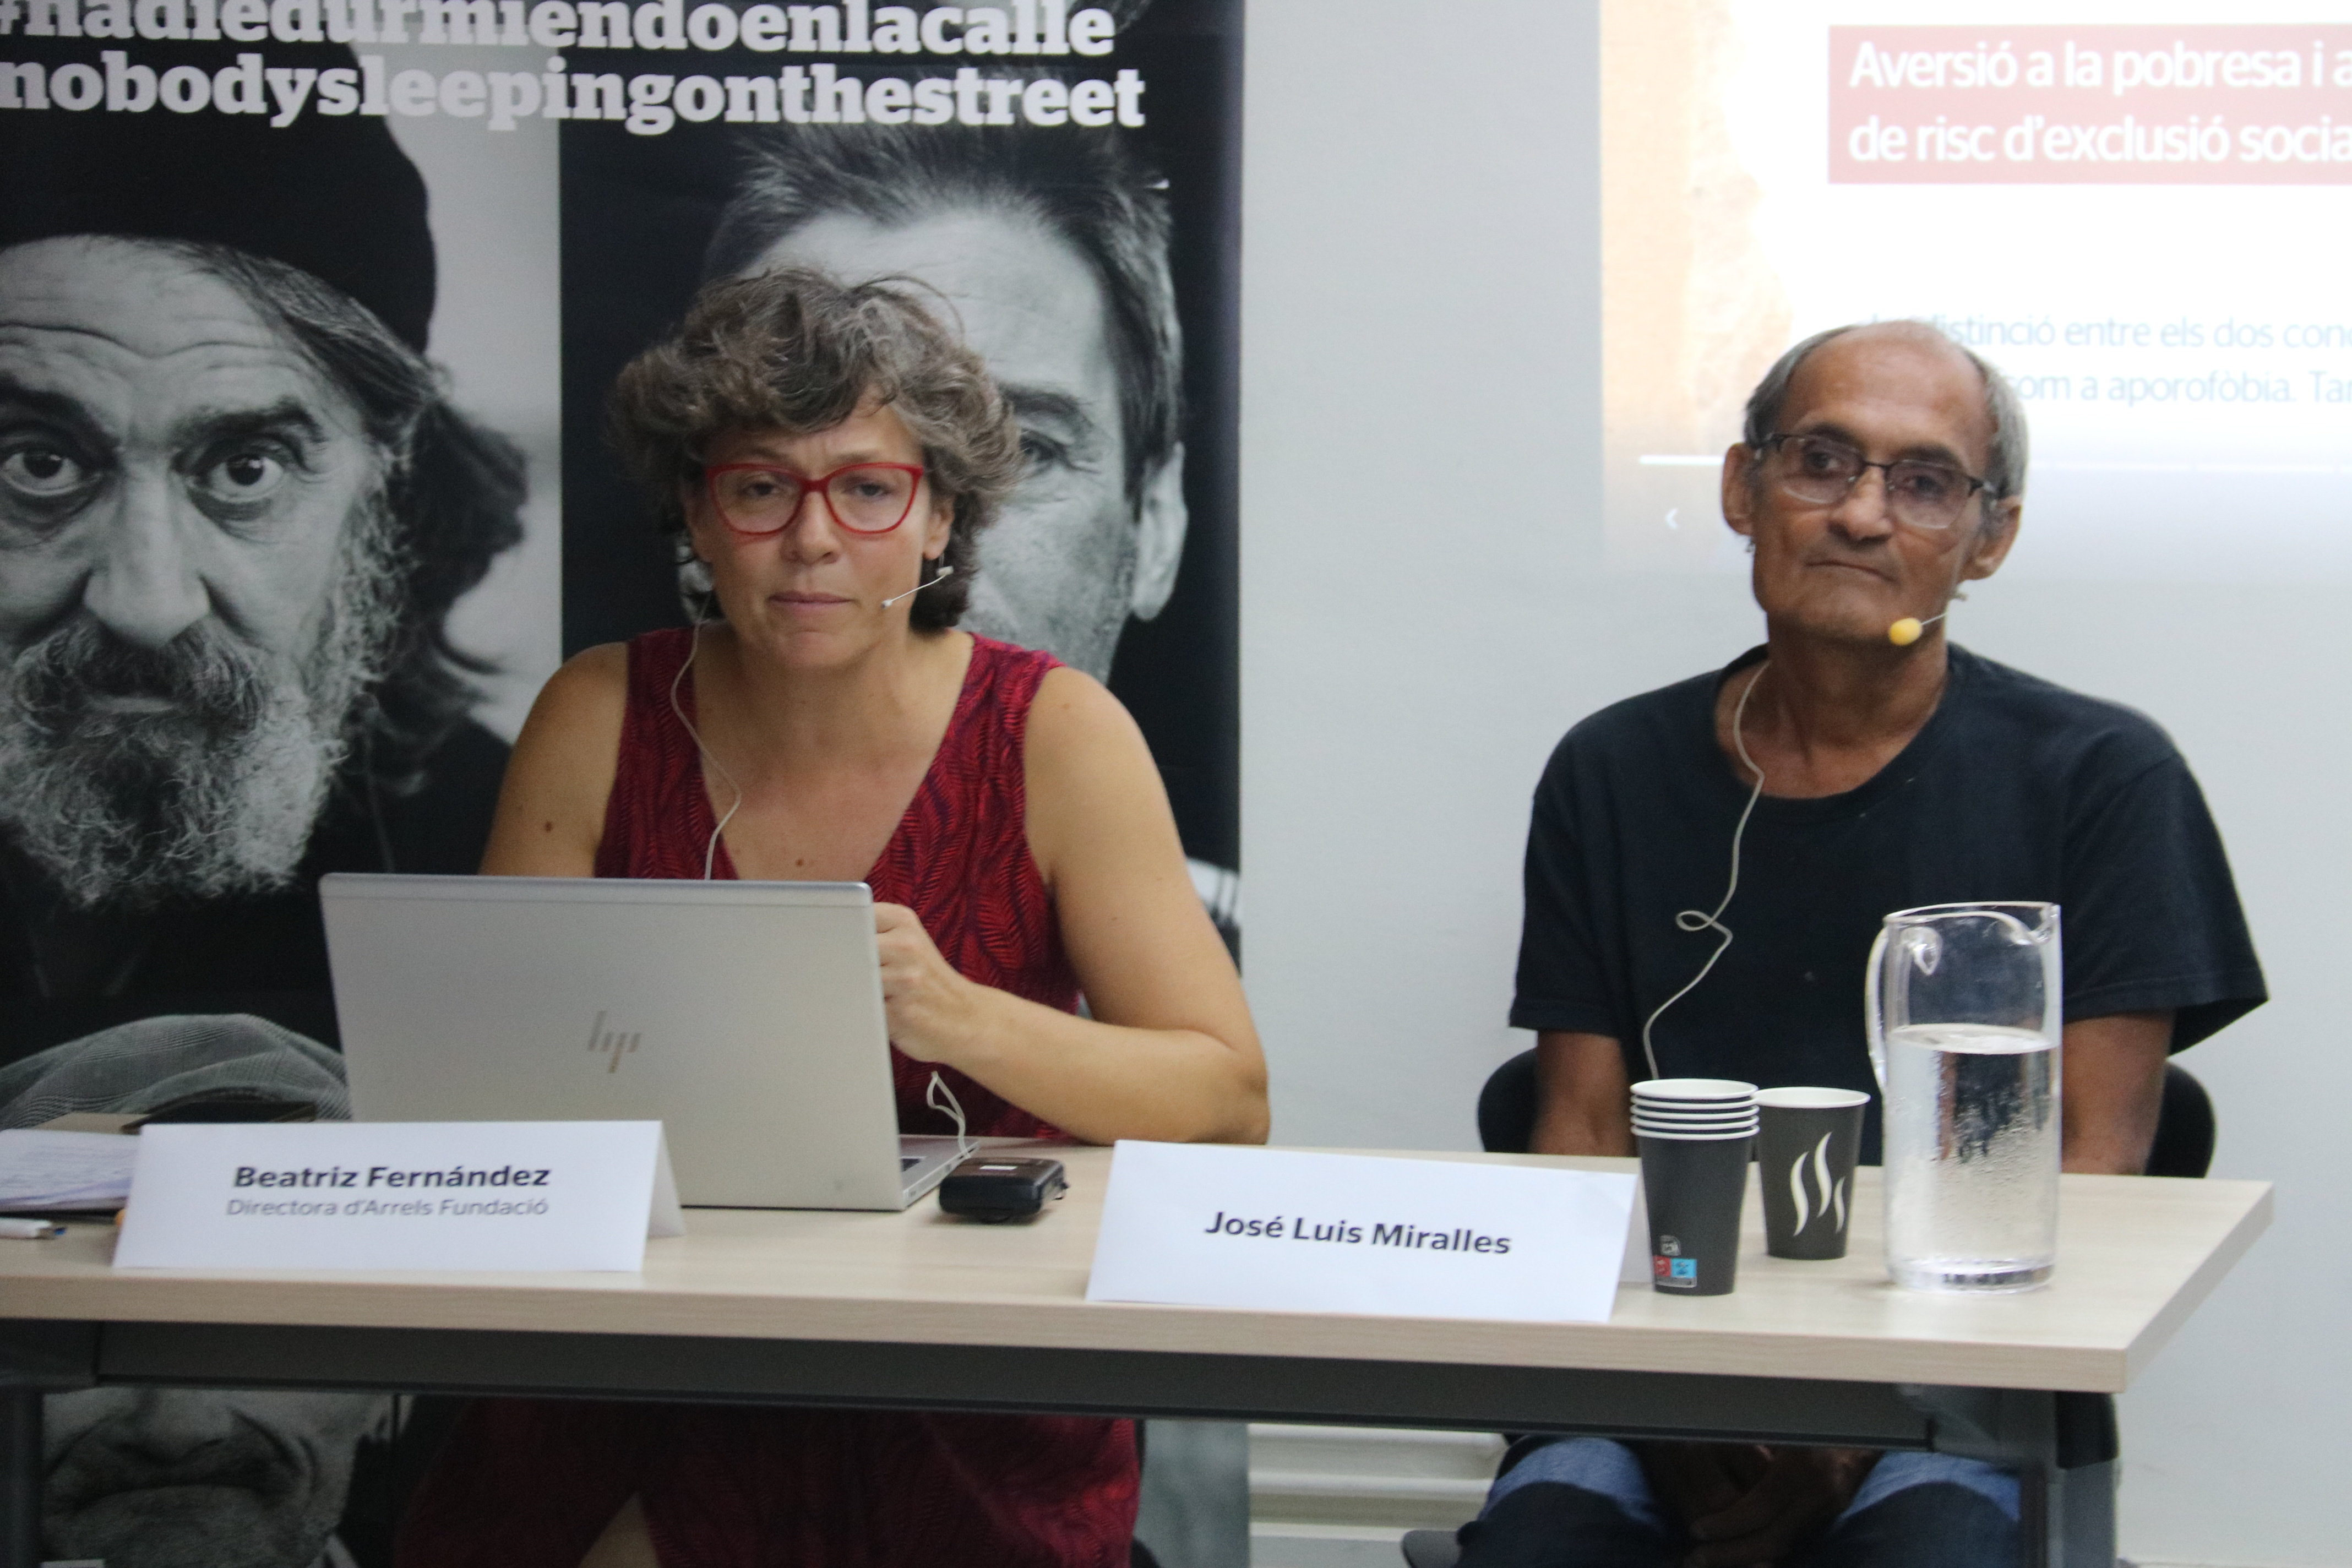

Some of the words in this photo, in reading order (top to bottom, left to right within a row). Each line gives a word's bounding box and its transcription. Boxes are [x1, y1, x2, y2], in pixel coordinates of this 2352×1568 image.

[1849, 40, 2018, 88] Aversió
[2026, 50, 2054, 87] a
[2065, 40, 2103, 87] la
[2113, 40, 2301, 96] pobresa
[2313, 40, 2324, 87] i
[0, 50, 1145, 135] nobodysleepingonthestreet
[1848, 115, 1908, 161] de
[1917, 115, 1996, 161] risc
[2064, 317, 2152, 347] entre
[2160, 315, 2206, 348] els
[2213, 317, 2274, 348] dos
[2080, 375, 2099, 401] a
[2107, 369, 2297, 409] aporofòbia.
[234, 1166, 358, 1188] Beatriz
[367, 1165, 551, 1188] Fernández
[226, 1199, 337, 1216] Directora
[438, 1197, 549, 1216] Fundació
[1205, 1211, 1284, 1238] José
[1293, 1217, 1363, 1244] Luis
[1372, 1223, 1511, 1254] Miralles
